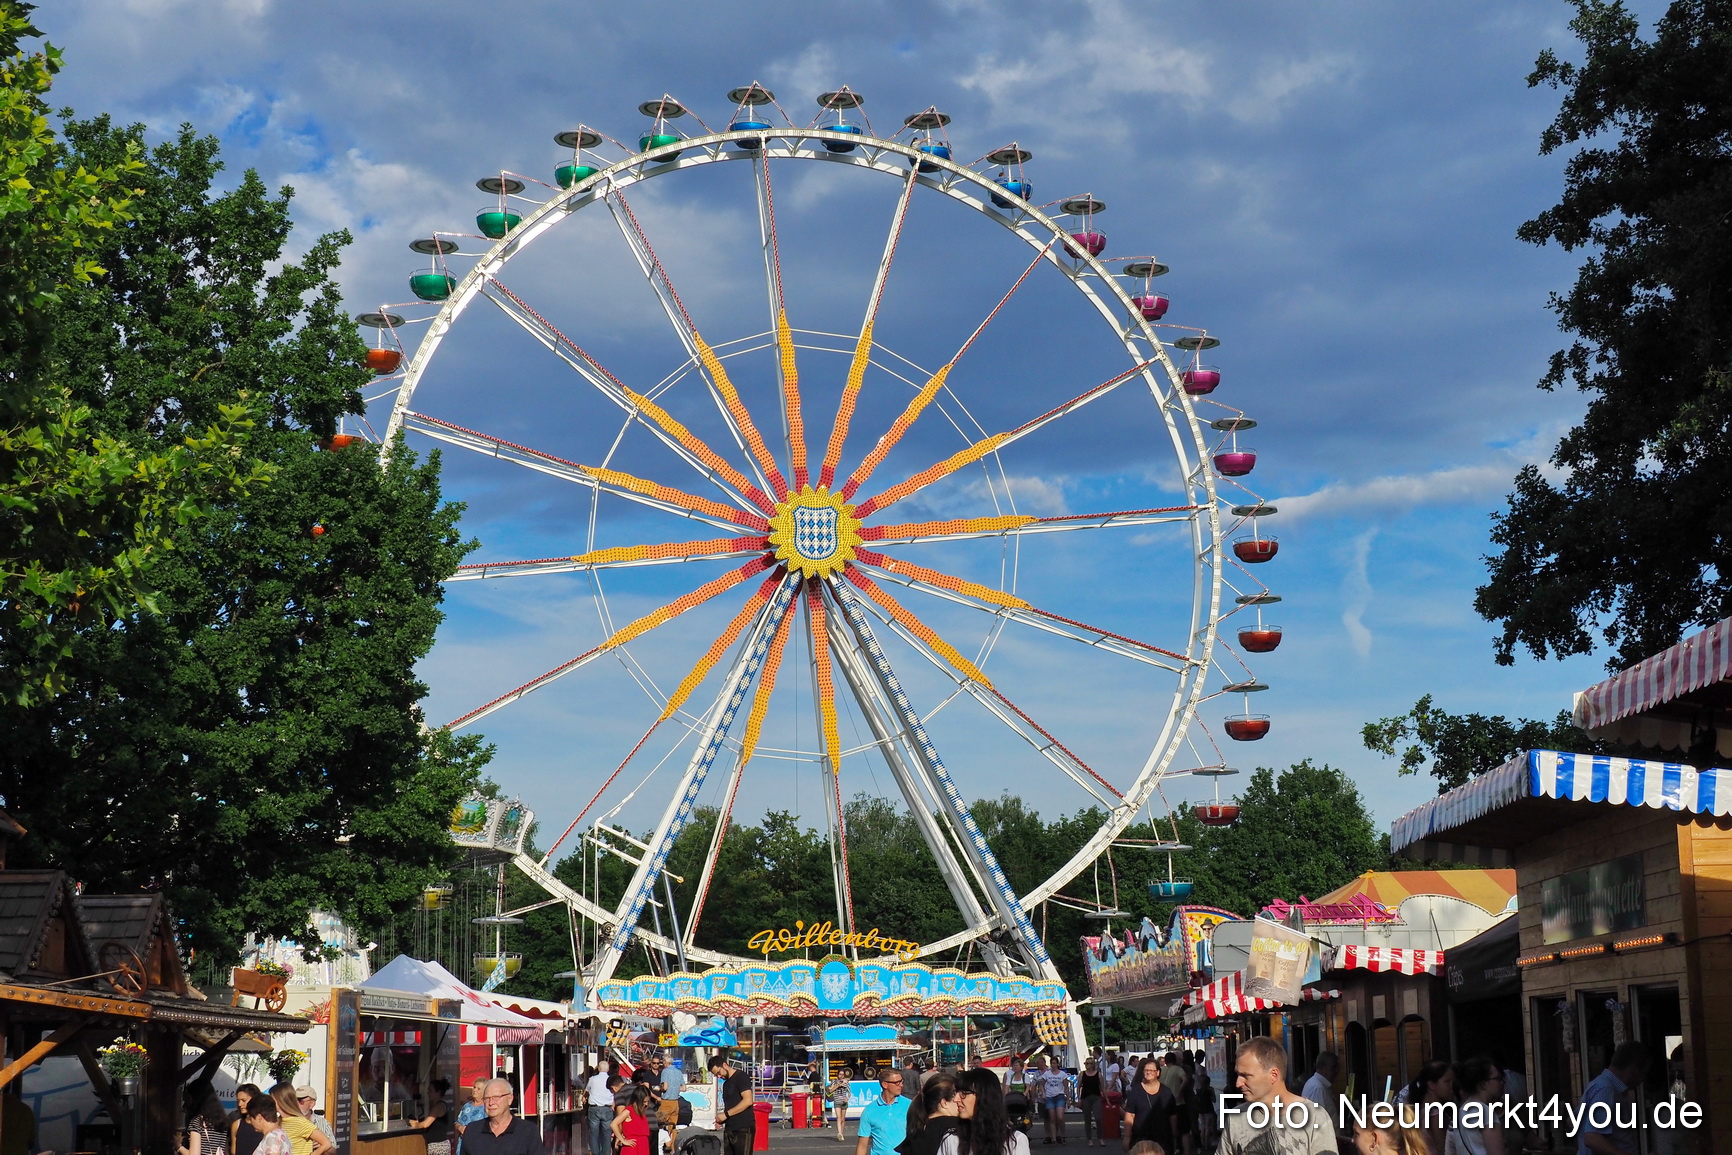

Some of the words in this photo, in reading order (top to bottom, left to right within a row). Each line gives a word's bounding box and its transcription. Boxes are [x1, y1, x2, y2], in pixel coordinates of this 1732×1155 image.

[747, 920, 921, 962] Willenborg
[1252, 937, 1281, 953] Coffee
[1283, 938, 1293, 953] to
[1295, 941, 1307, 957] go
